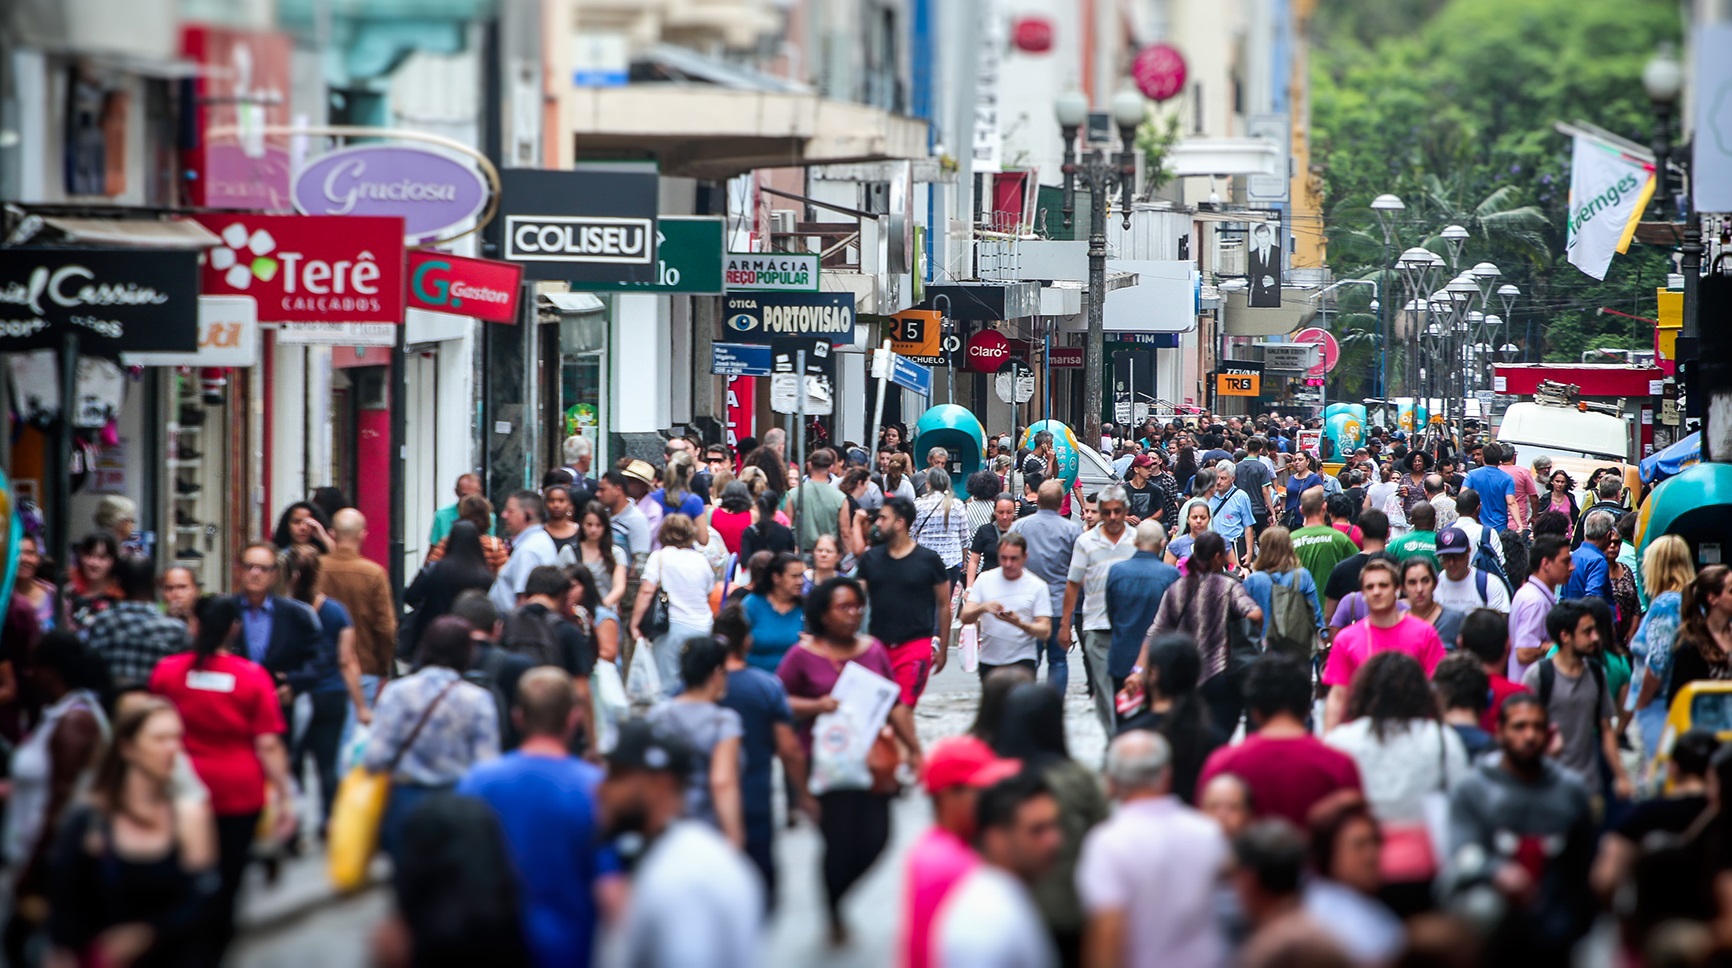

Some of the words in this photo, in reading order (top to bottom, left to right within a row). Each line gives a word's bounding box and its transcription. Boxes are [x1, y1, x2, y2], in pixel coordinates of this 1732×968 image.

[323, 158, 456, 215] Graciosa
[514, 225, 644, 255] COLISEU
[277, 250, 381, 294] Terê
[728, 258, 809, 272] ARMÁCIA
[726, 270, 755, 285] REÇO
[449, 281, 509, 305] Gaston
[282, 297, 381, 314] CALÇADOS
[729, 299, 758, 309] ÓTICA
[763, 299, 852, 333] PORTOVISÃO
[1135, 334, 1155, 344] TIM
[969, 345, 1003, 357] Claro
[1049, 353, 1082, 364] marisa
